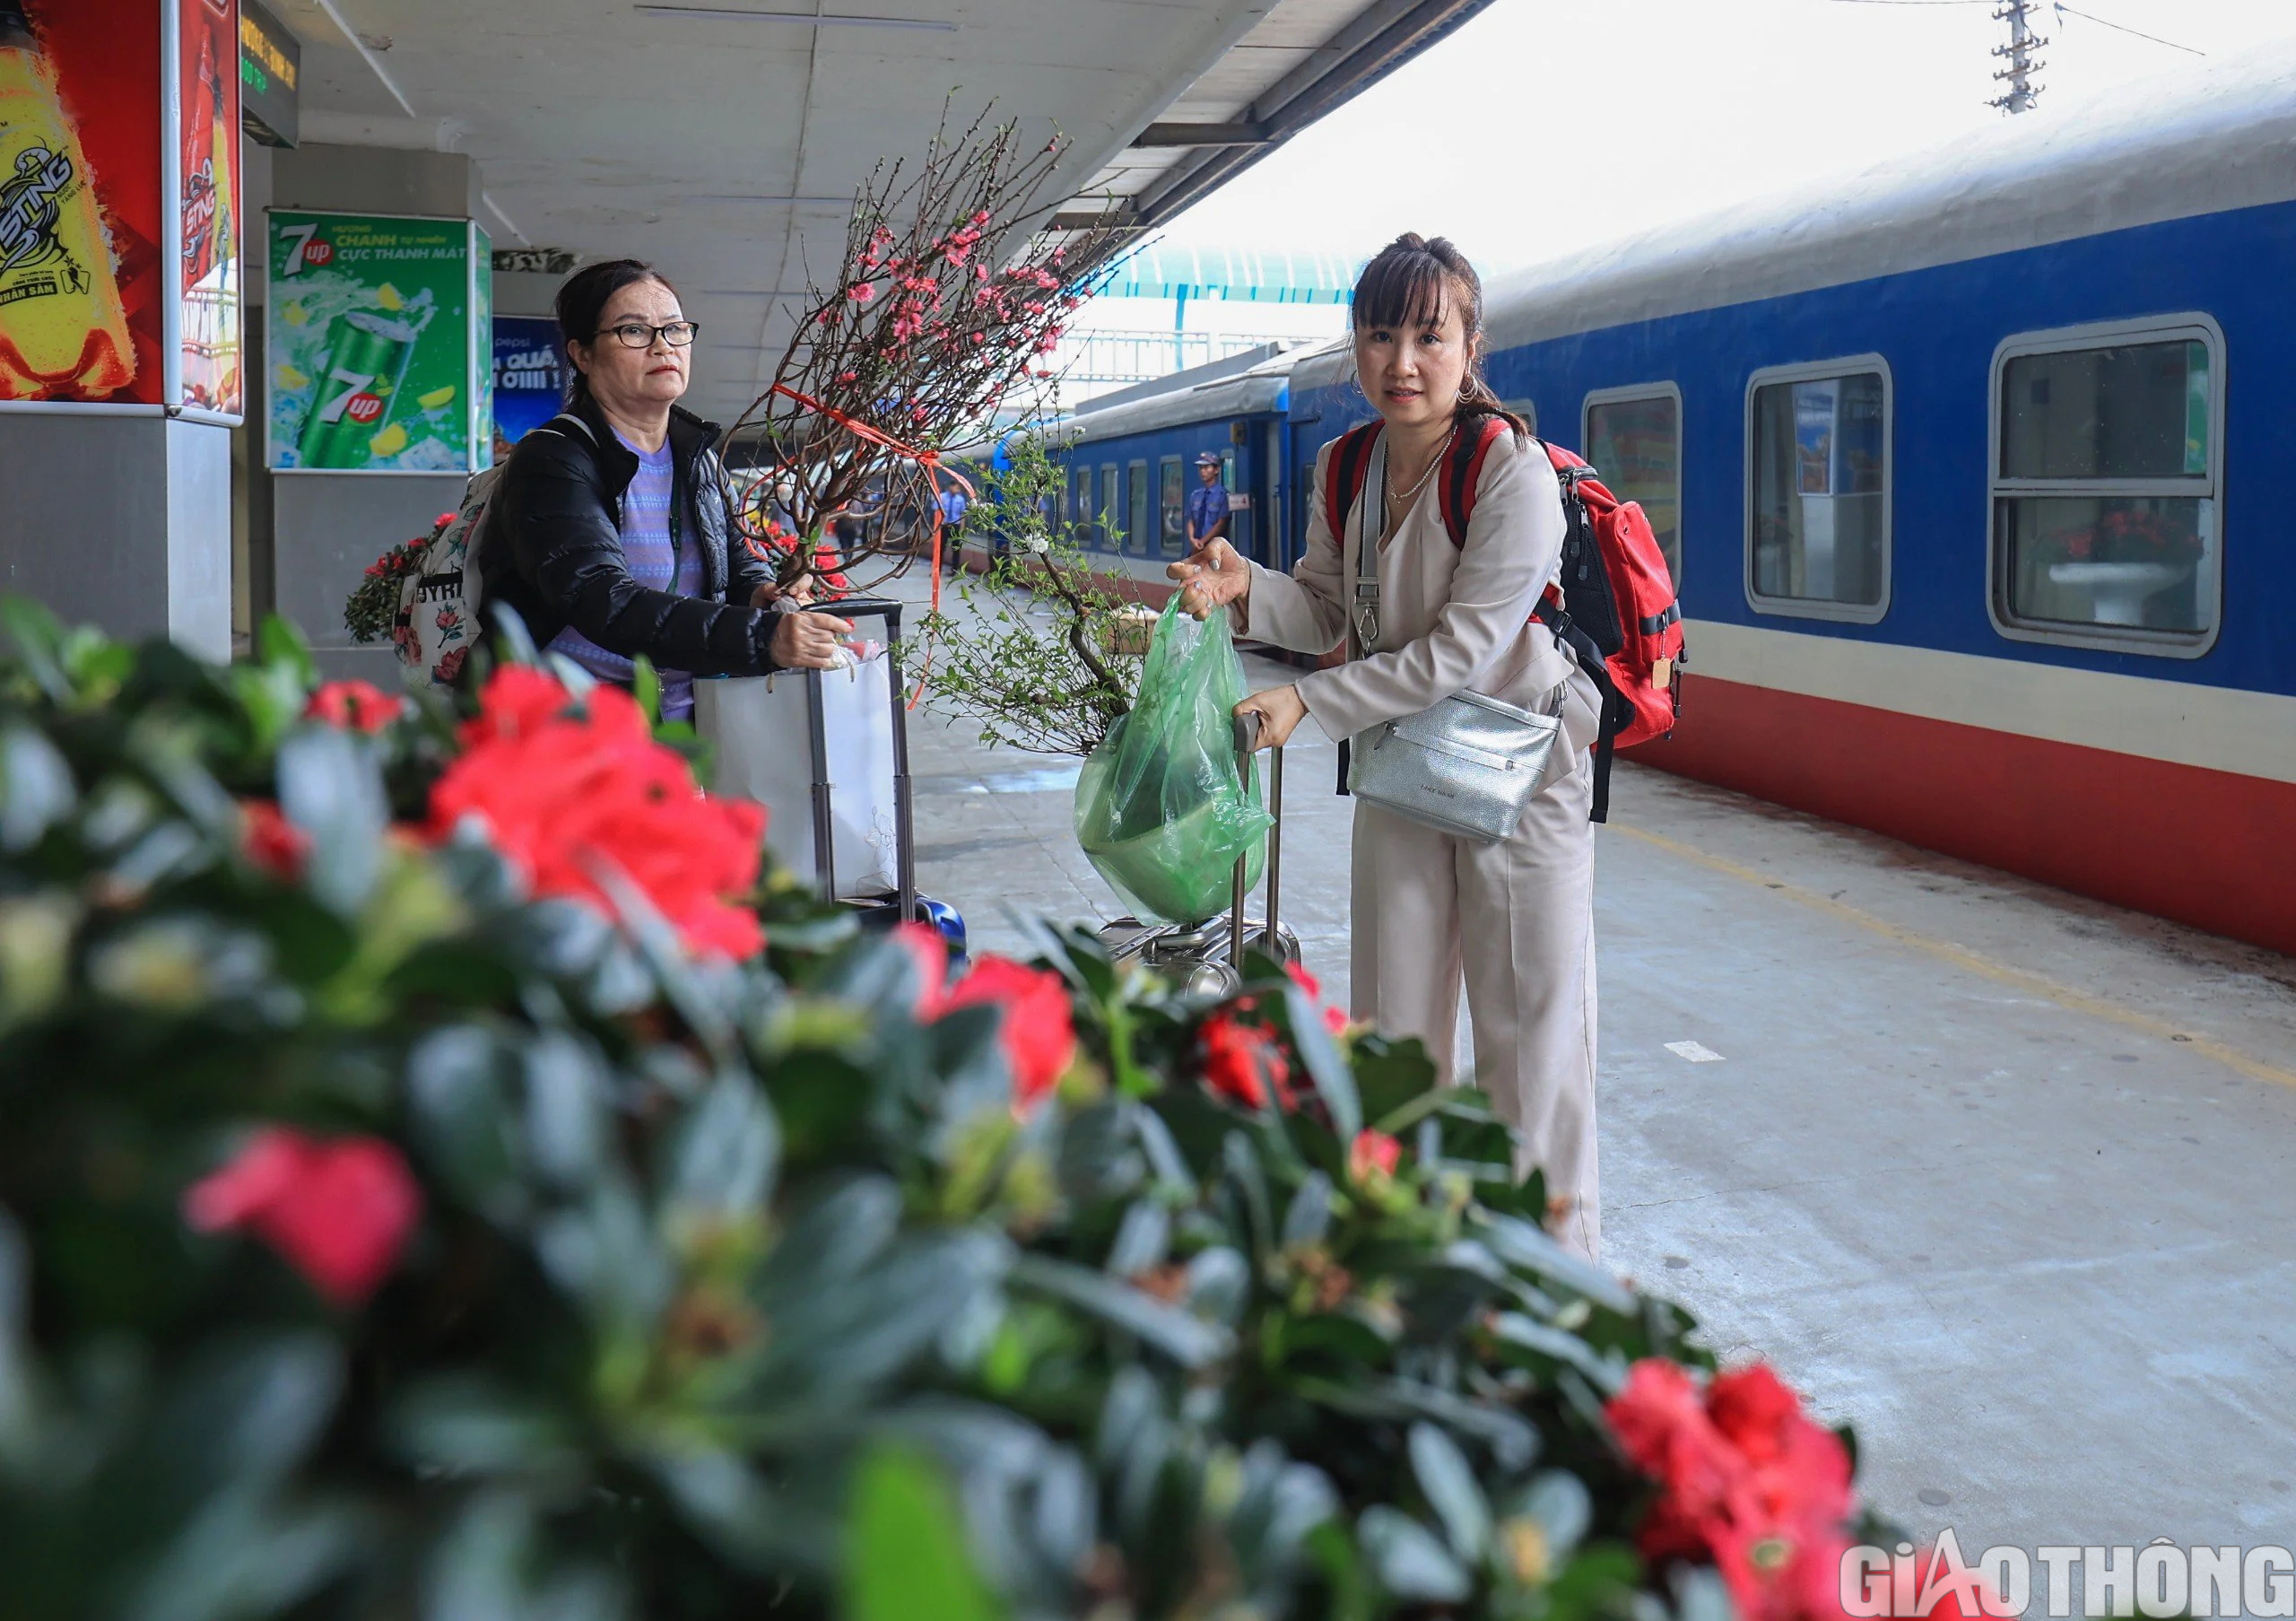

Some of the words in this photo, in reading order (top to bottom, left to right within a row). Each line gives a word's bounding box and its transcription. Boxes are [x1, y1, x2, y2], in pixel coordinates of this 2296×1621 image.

[0, 154, 73, 253] STING
[336, 234, 397, 247] CHANH
[338, 248, 370, 262] CỰC
[374, 248, 430, 259] THANH
[431, 244, 467, 259] MÁT
